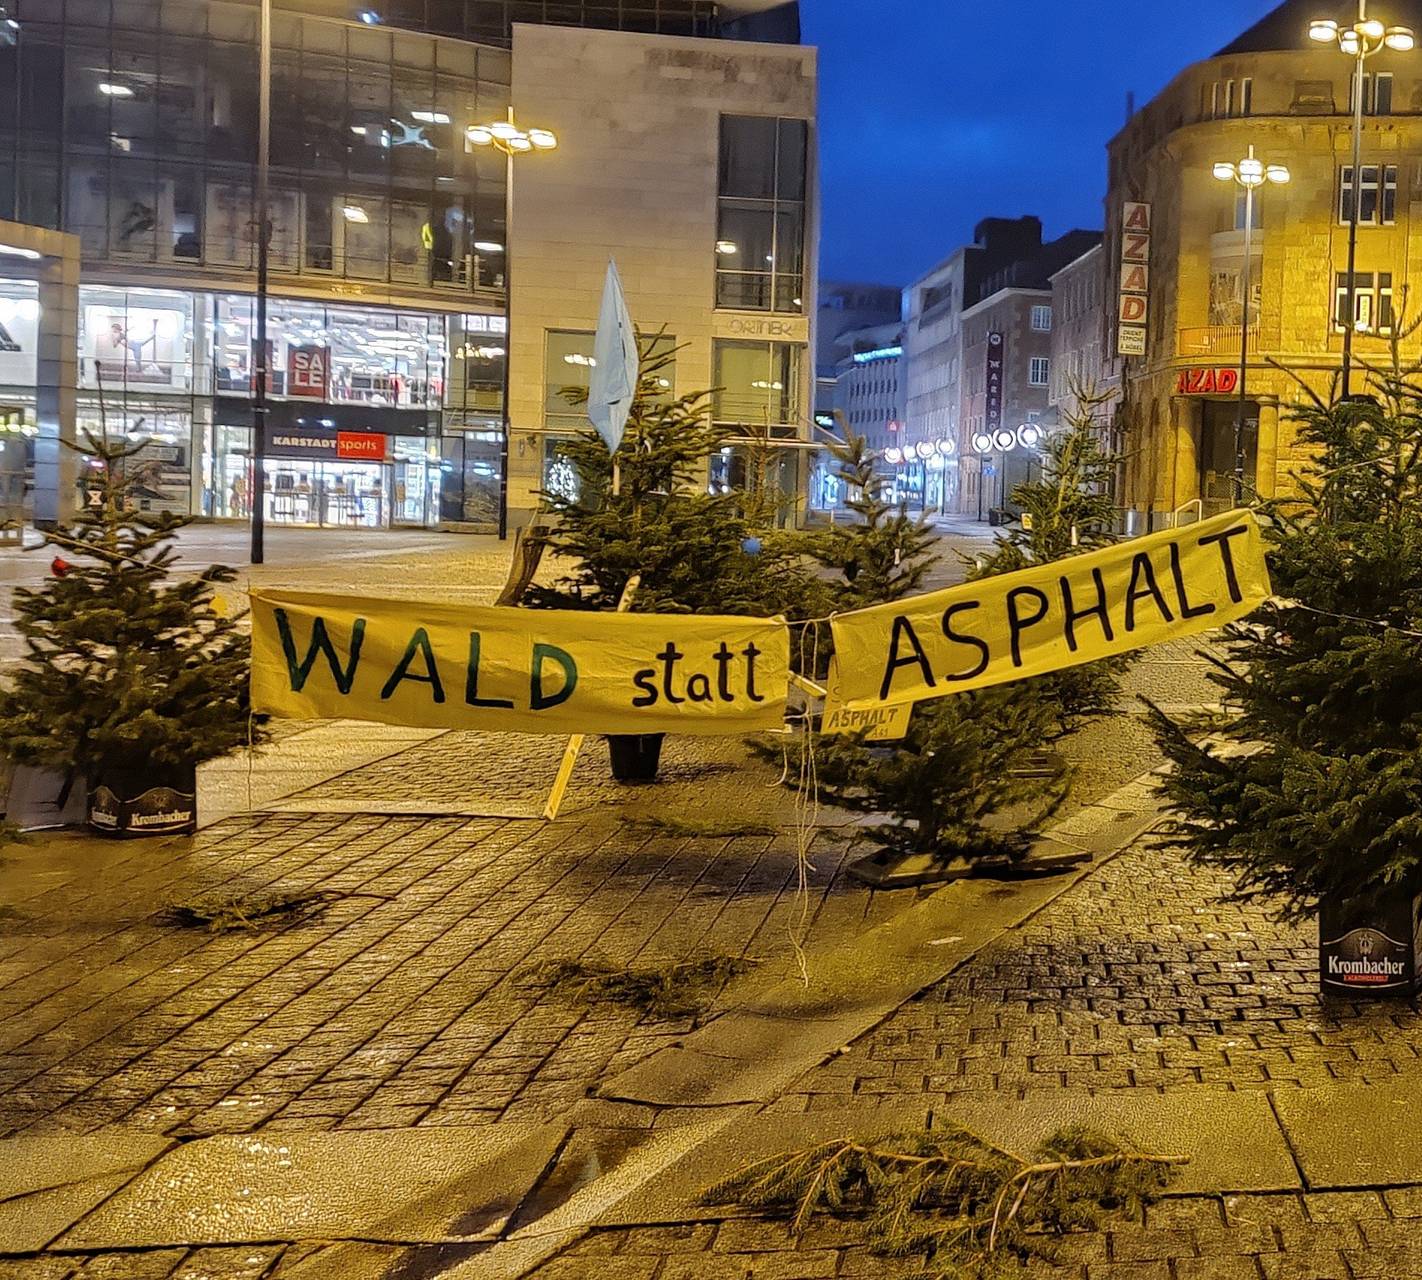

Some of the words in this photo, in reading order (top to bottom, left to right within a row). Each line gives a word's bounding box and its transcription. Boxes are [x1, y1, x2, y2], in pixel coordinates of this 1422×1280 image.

[1121, 204, 1149, 320] AZAD
[1177, 367, 1238, 393] AZAD
[272, 436, 337, 449] KARSTADT
[340, 440, 377, 451] sports
[879, 525, 1249, 700] ASPHALT
[273, 608, 578, 710] WALD
[632, 641, 765, 707] statt
[828, 707, 899, 728] ASPHALT
[131, 809, 191, 827] Krombacher
[1328, 955, 1405, 975] Krombacher
